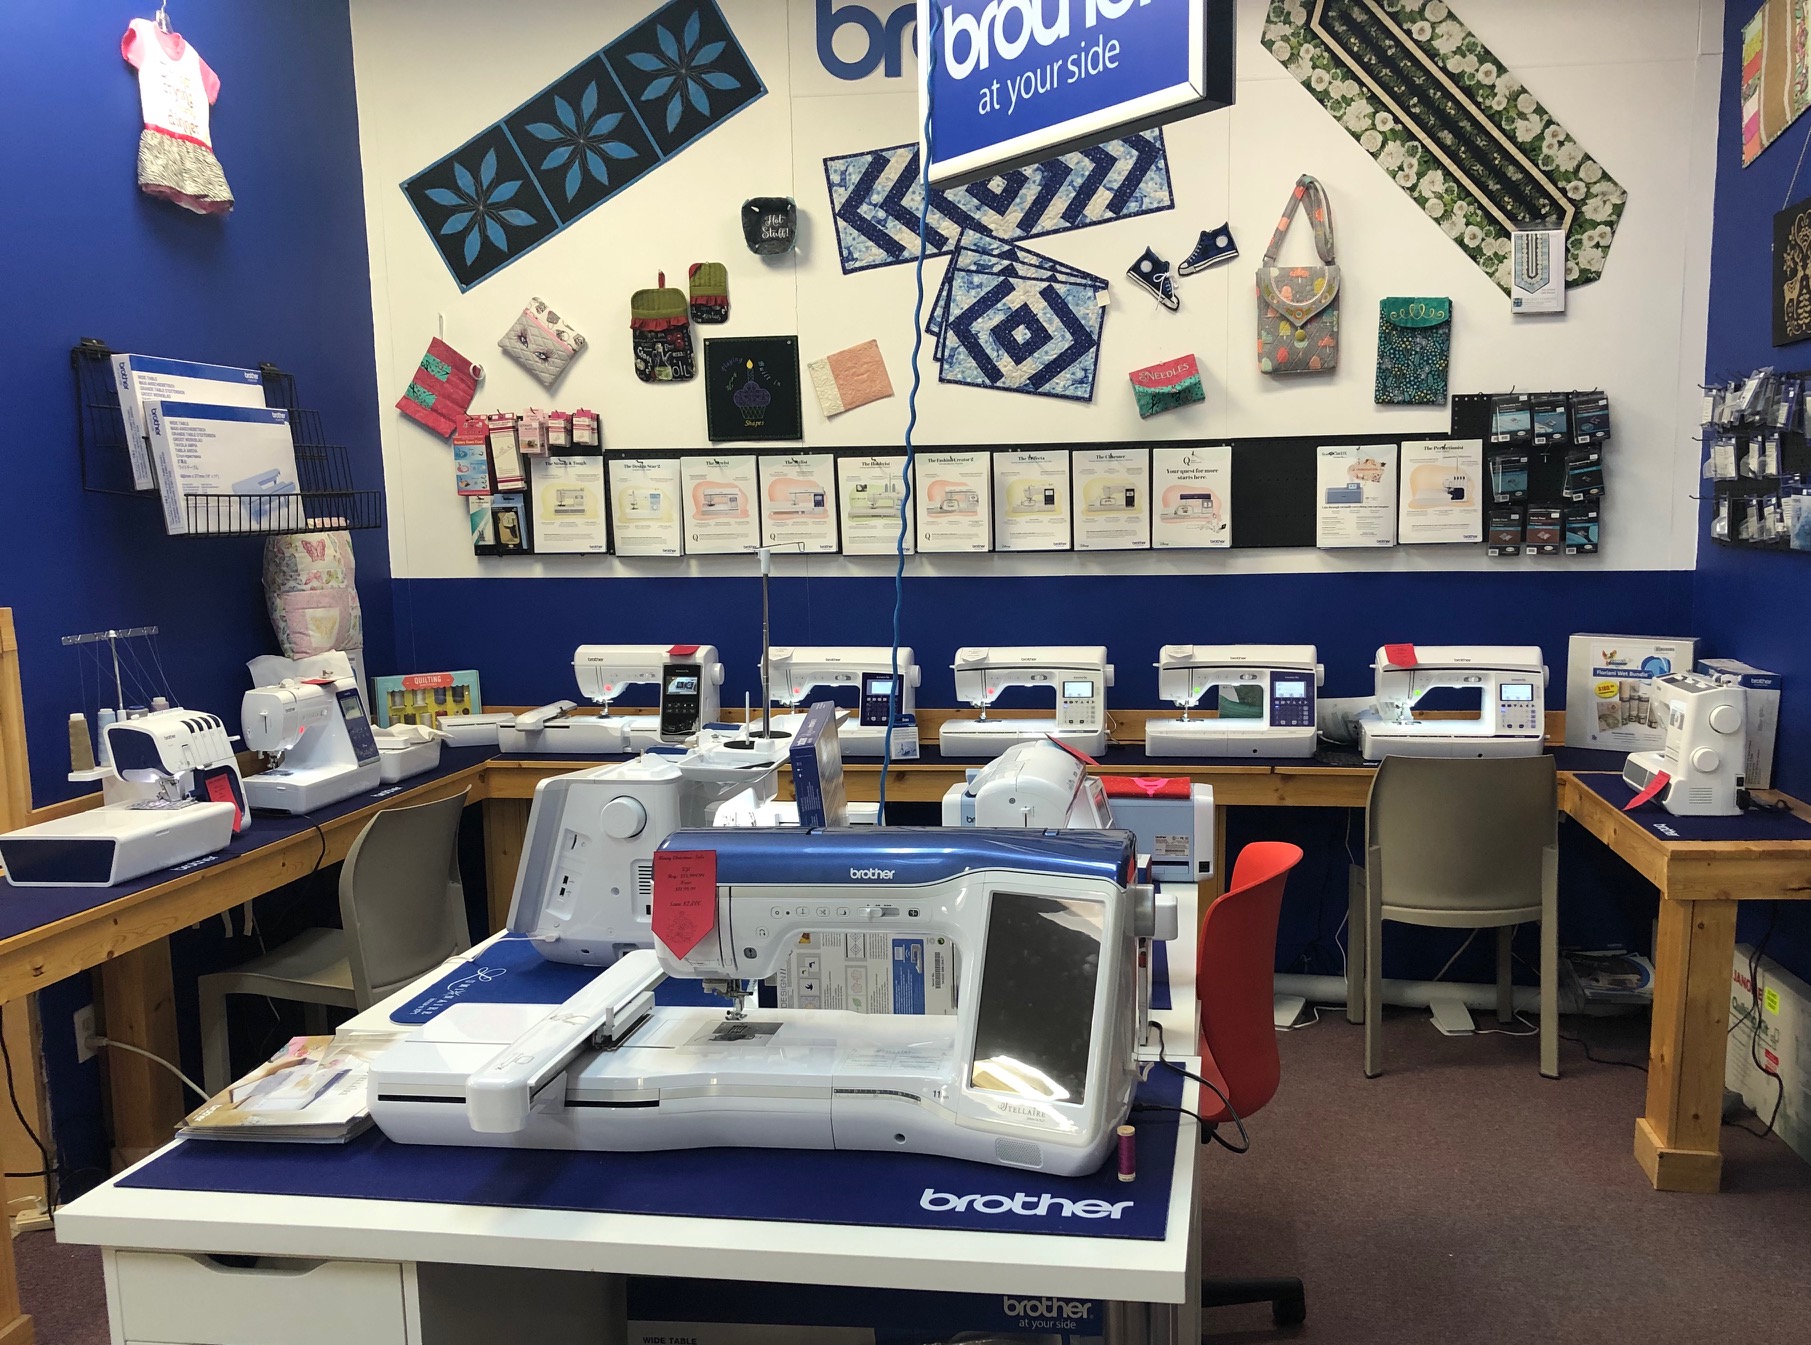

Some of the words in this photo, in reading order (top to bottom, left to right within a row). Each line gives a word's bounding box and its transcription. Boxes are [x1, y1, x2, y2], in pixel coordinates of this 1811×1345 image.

[978, 78, 1001, 115] at
[1007, 58, 1063, 116] your
[1067, 38, 1121, 84] side
[765, 214, 785, 226] Hot
[761, 226, 789, 240] Stuff!
[118, 361, 129, 391] brother
[244, 371, 259, 380] brother
[1139, 362, 1190, 383] NEEDLES
[151, 408, 161, 436] brother
[271, 411, 286, 419] brother
[414, 675, 442, 684] QUILTING
[1653, 823, 1680, 837] brother
[850, 868, 895, 879] brother
[780, 975, 788, 1009] DESIGN
[1733, 970, 1763, 1002] JANOE
[997, 1102, 1046, 1118] STELLAIRE
[919, 1188, 1134, 1220] brother
[1003, 1296, 1092, 1320] brother
[1019, 1320, 1028, 1328] at
[1030, 1320, 1051, 1330] your
[1054, 1319, 1077, 1329] side
[642, 1336, 666, 1344] WIDE
[668, 1337, 697, 1345] TABLE
